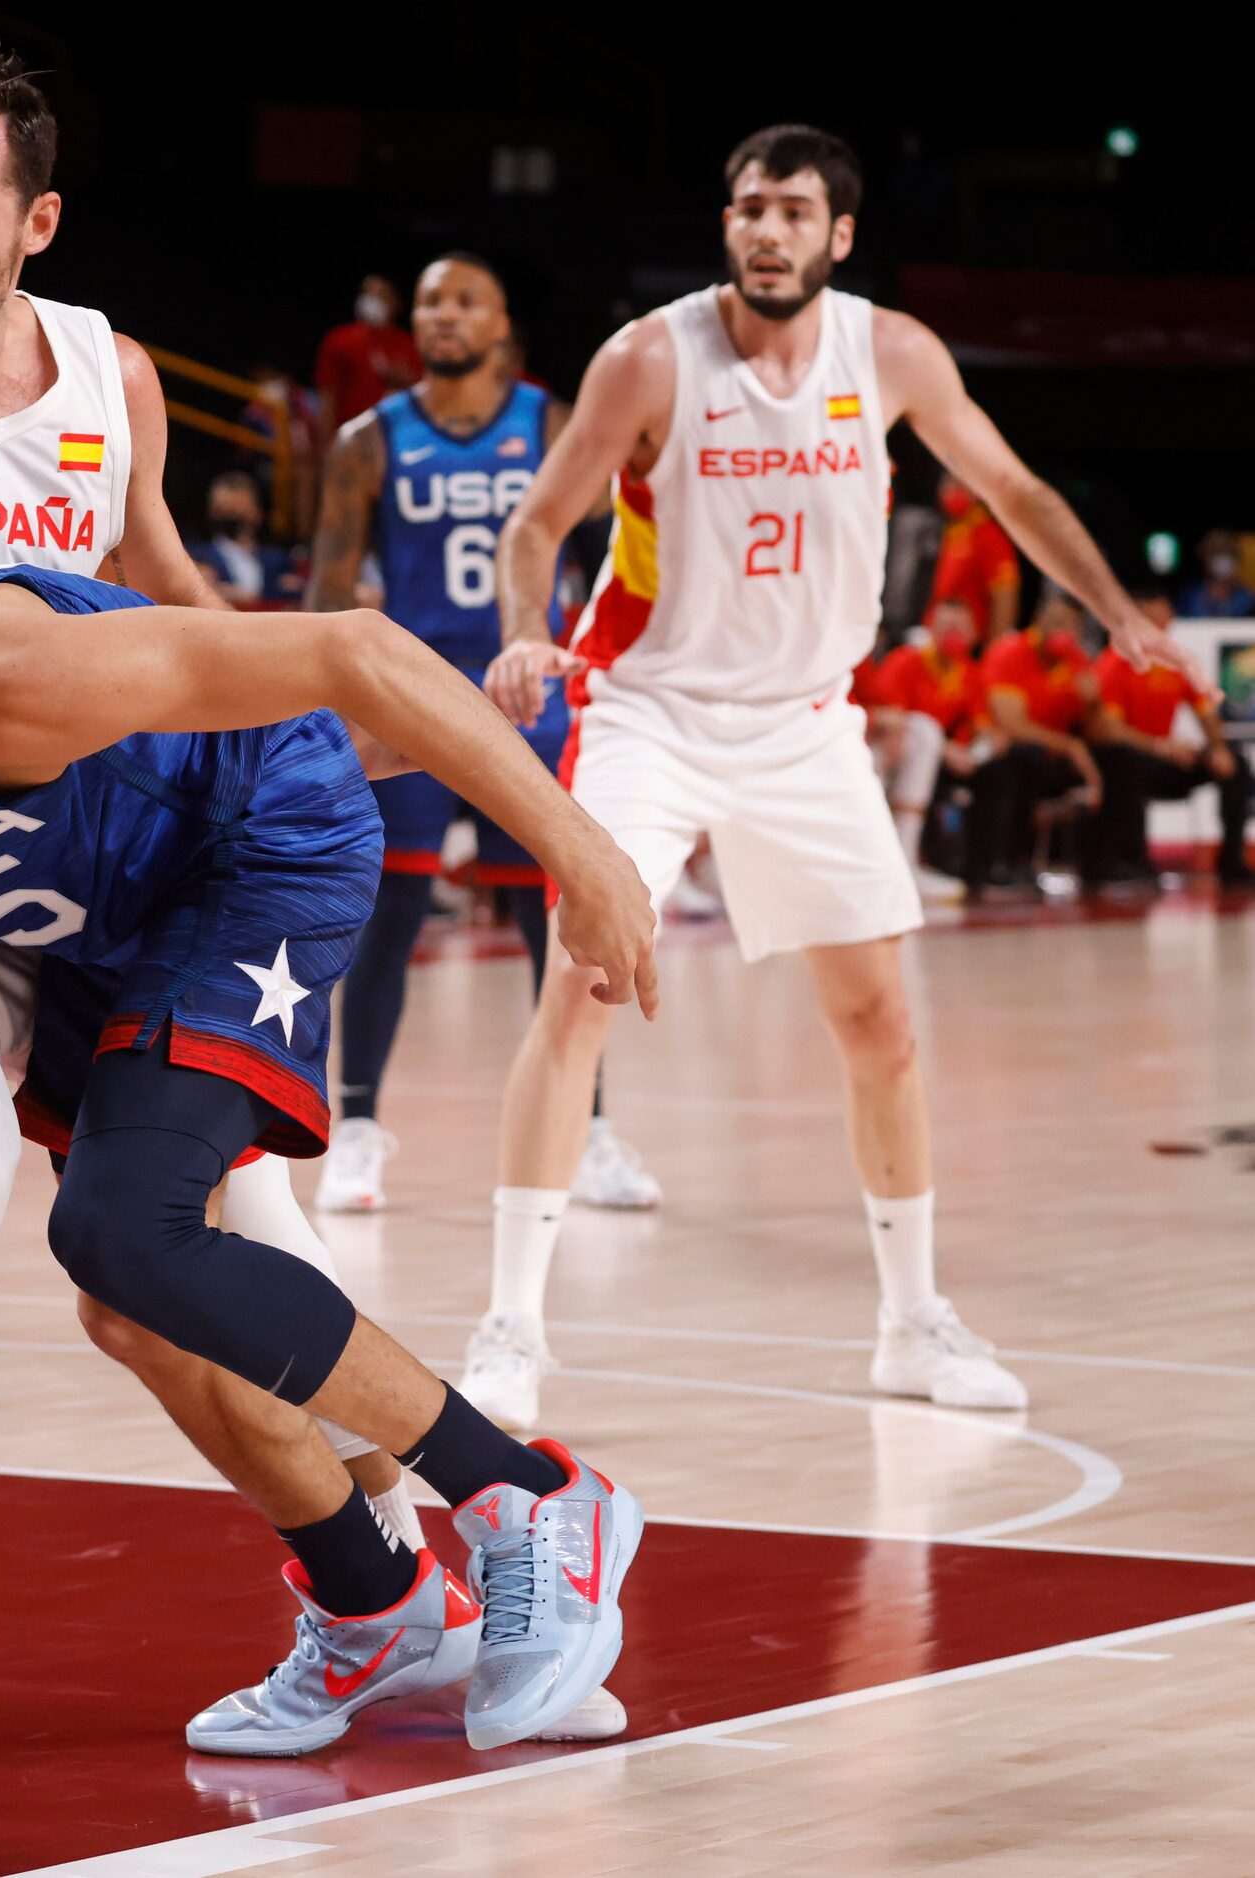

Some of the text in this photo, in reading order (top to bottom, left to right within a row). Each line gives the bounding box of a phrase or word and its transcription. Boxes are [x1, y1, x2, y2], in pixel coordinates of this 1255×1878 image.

[700, 440, 861, 478] ESPAÑA
[396, 469, 536, 524] USA
[445, 524, 497, 609] 6
[746, 511, 803, 577] 21
